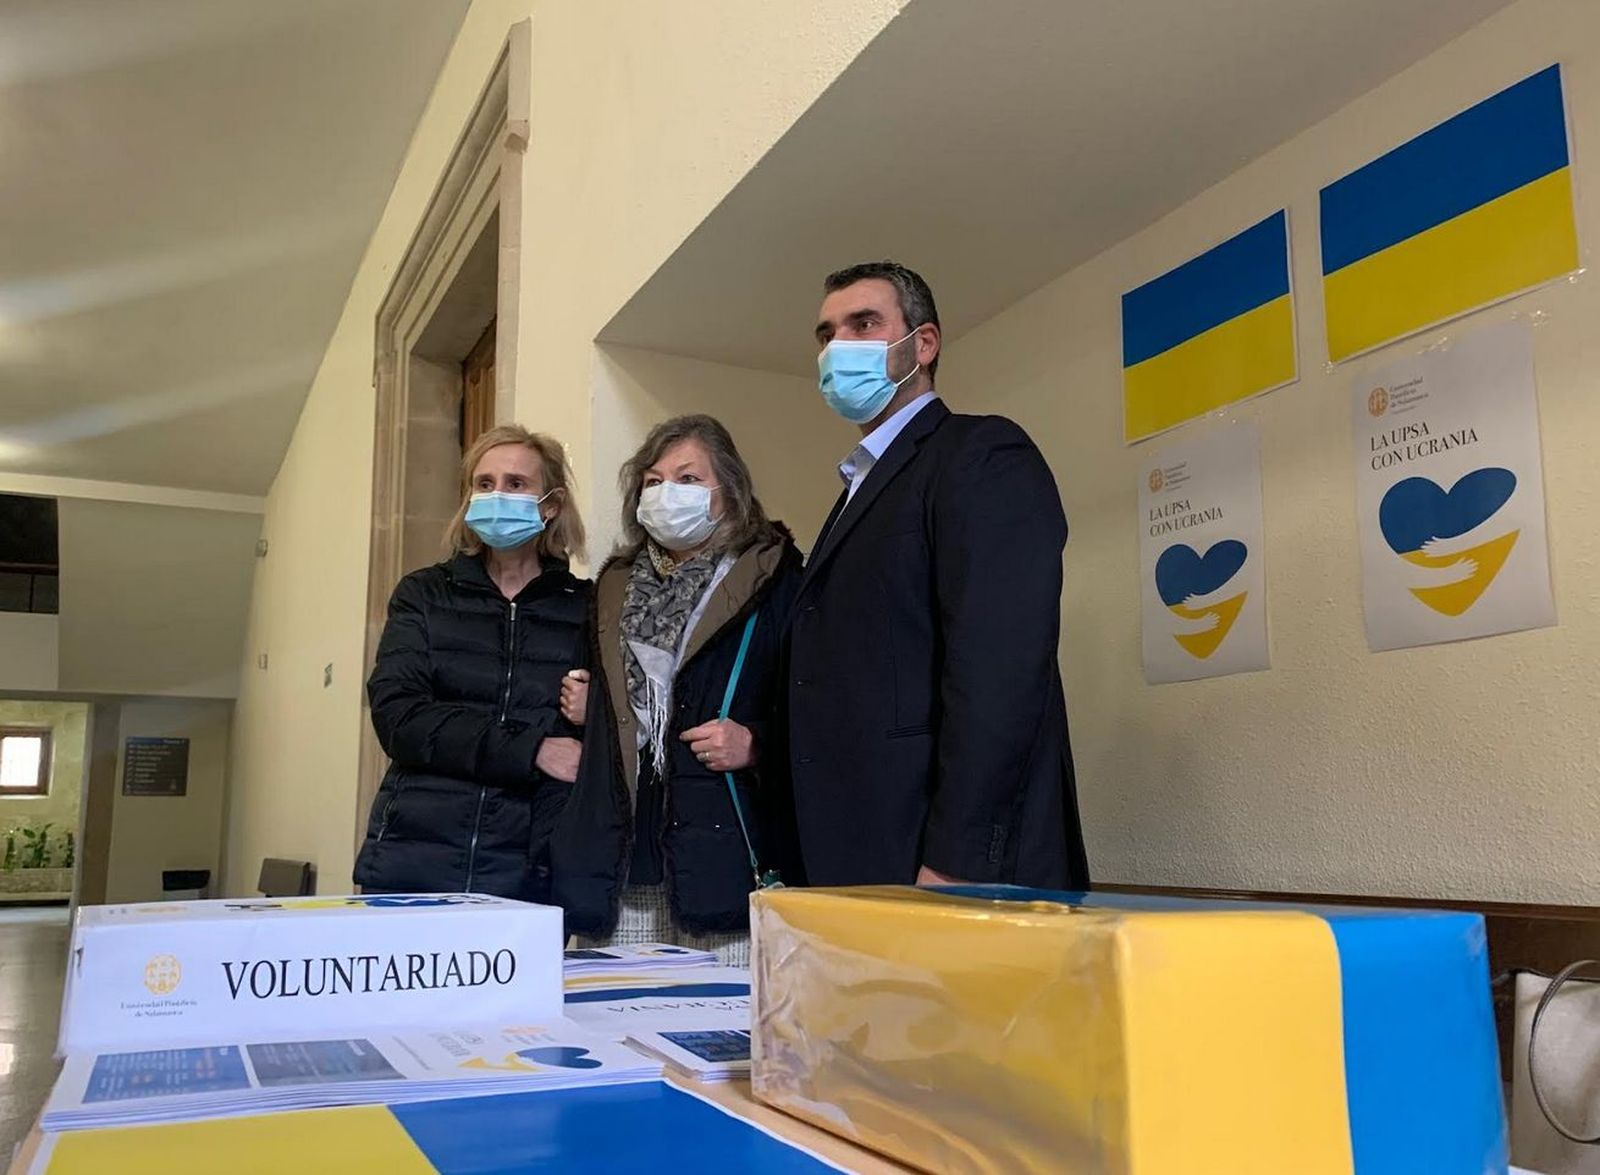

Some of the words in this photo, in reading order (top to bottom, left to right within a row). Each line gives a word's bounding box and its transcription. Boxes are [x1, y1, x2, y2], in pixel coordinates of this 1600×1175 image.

[1371, 434, 1389, 452] LA
[1391, 421, 1430, 445] UPSA
[1371, 449, 1403, 471] CON
[1406, 427, 1479, 461] UCRANIA
[1149, 507, 1163, 522] LA
[1165, 499, 1192, 517] UPSA
[1149, 521, 1173, 537] CON
[1174, 507, 1224, 531] UCRANIA
[221, 948, 517, 1001] VOLUNTARIADO
